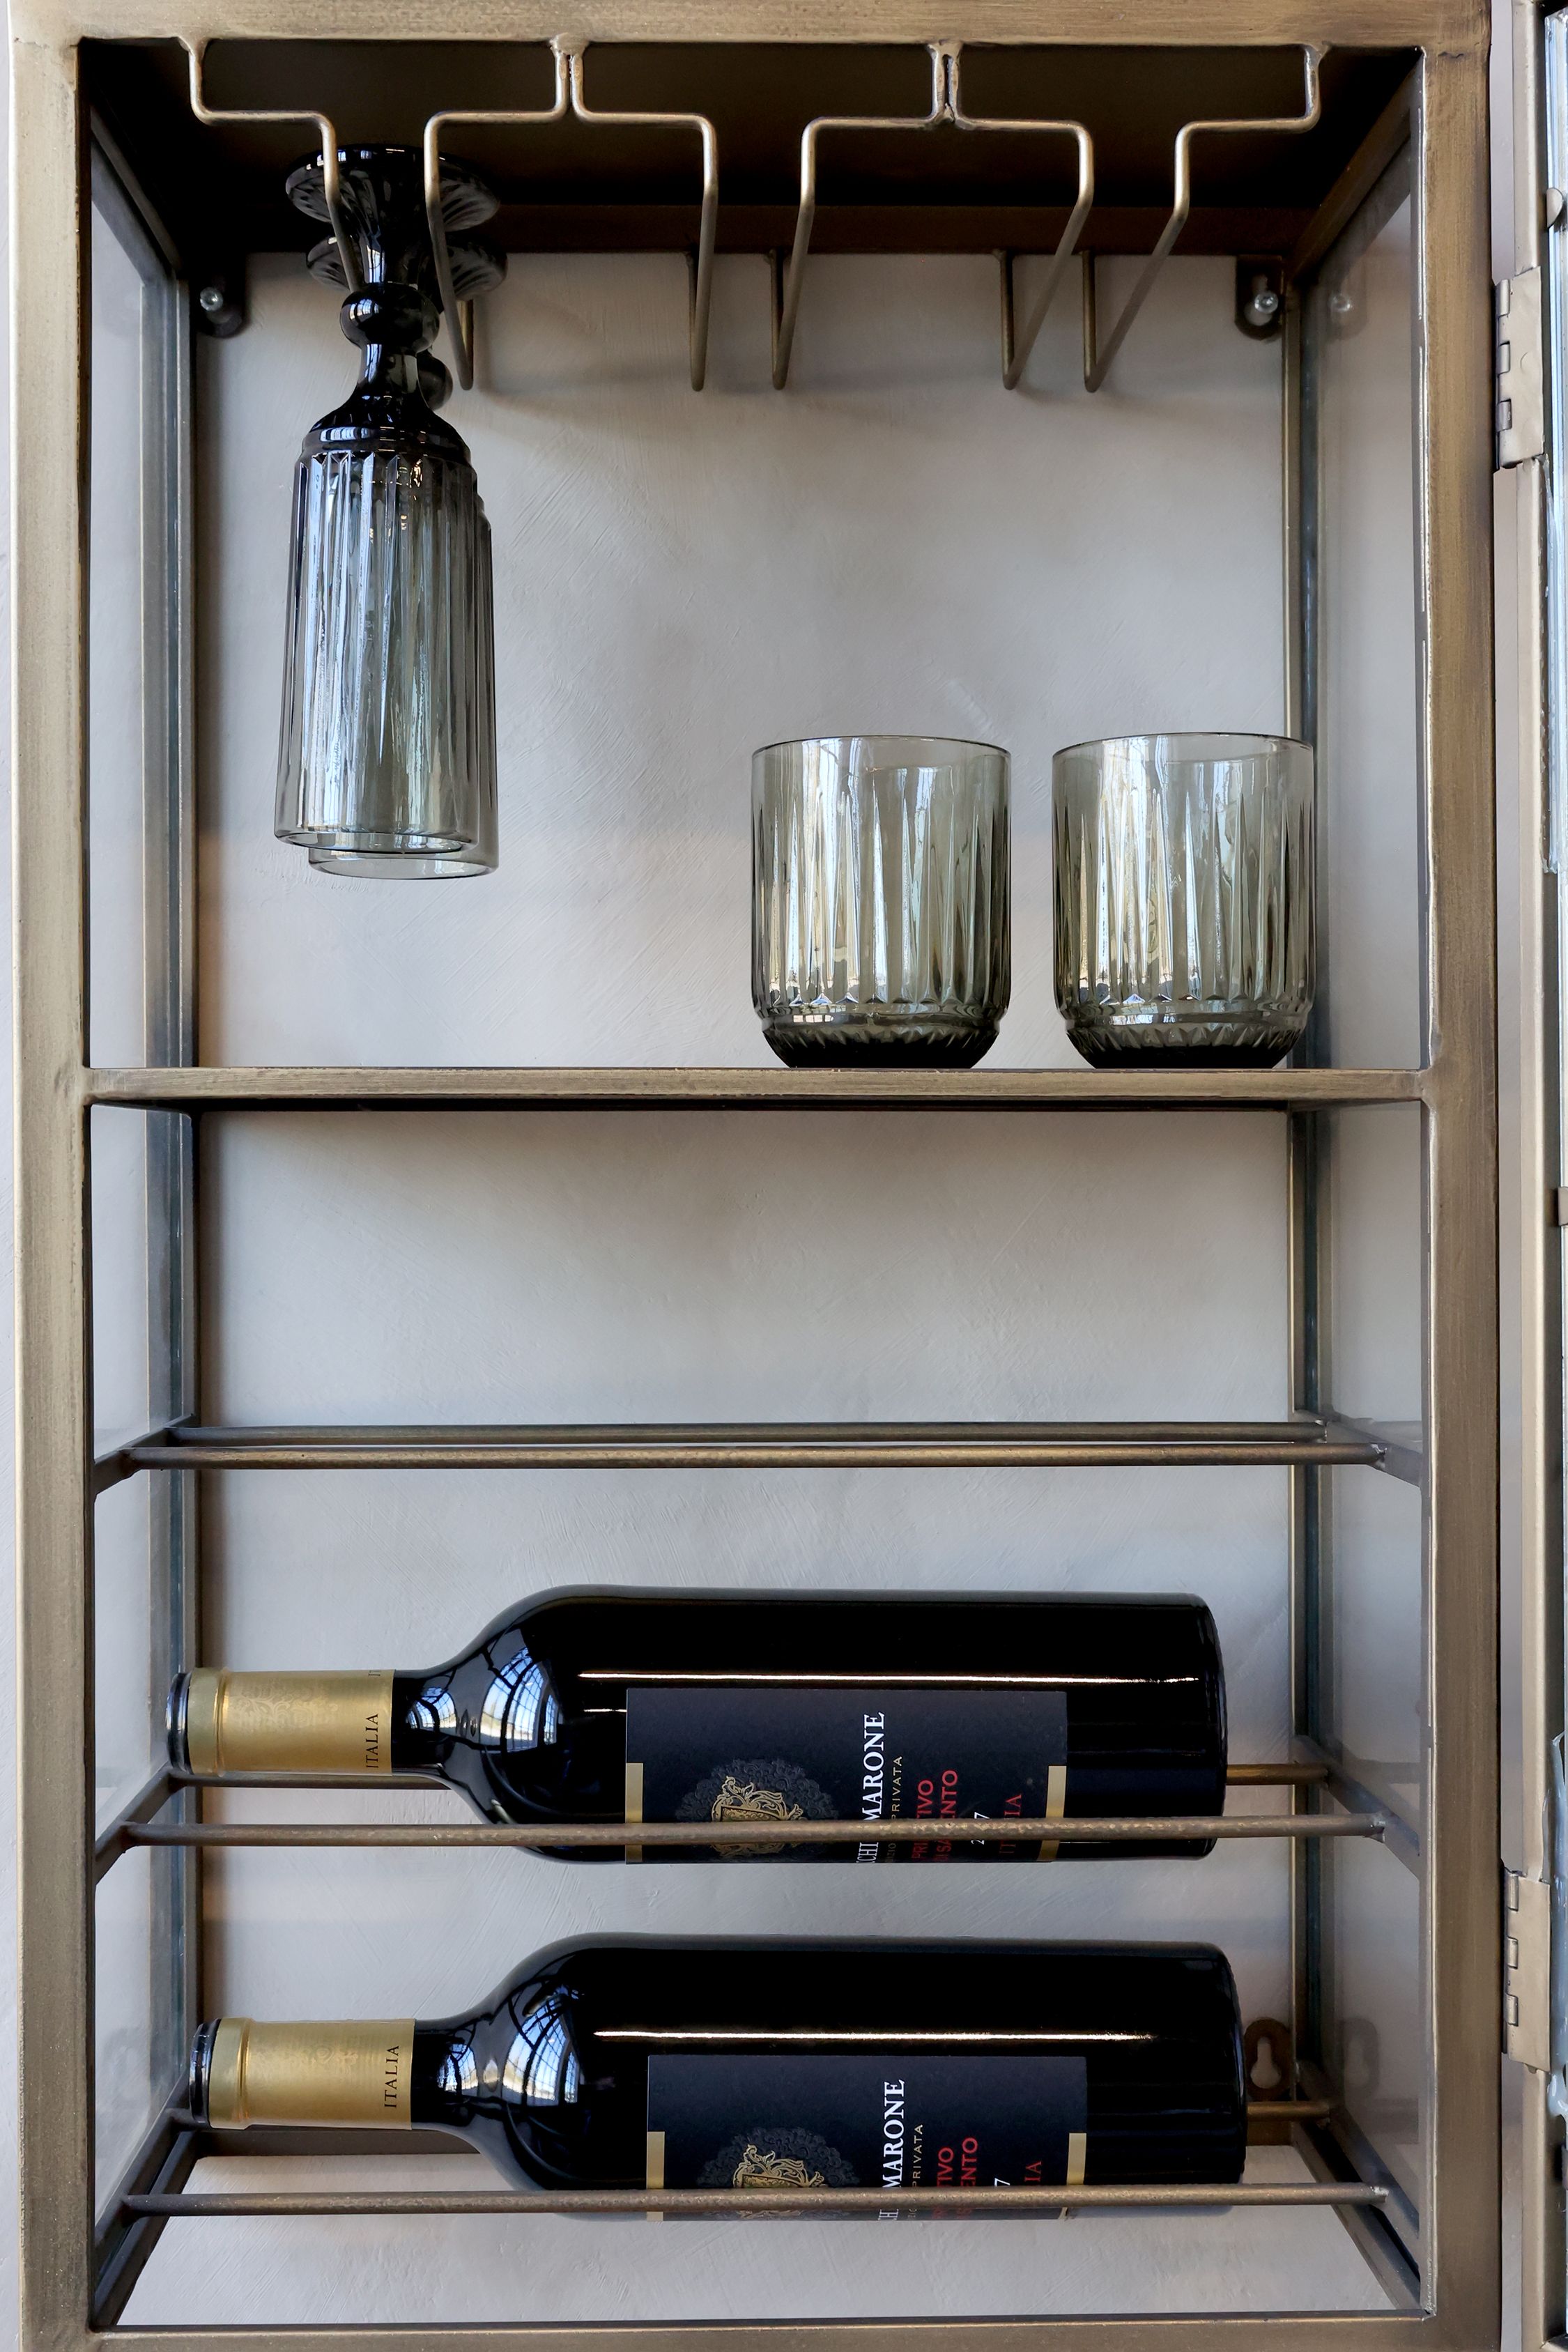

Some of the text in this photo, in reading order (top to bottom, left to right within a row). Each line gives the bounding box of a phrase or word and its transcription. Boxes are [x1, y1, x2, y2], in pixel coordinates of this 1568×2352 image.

[366, 1714, 378, 1769] ITALIA
[862, 1712, 885, 1821] MARONE
[999, 1794, 1022, 1854] ITIA
[384, 2045, 399, 2108] ITALIA
[882, 2079, 905, 2188] MARONE
